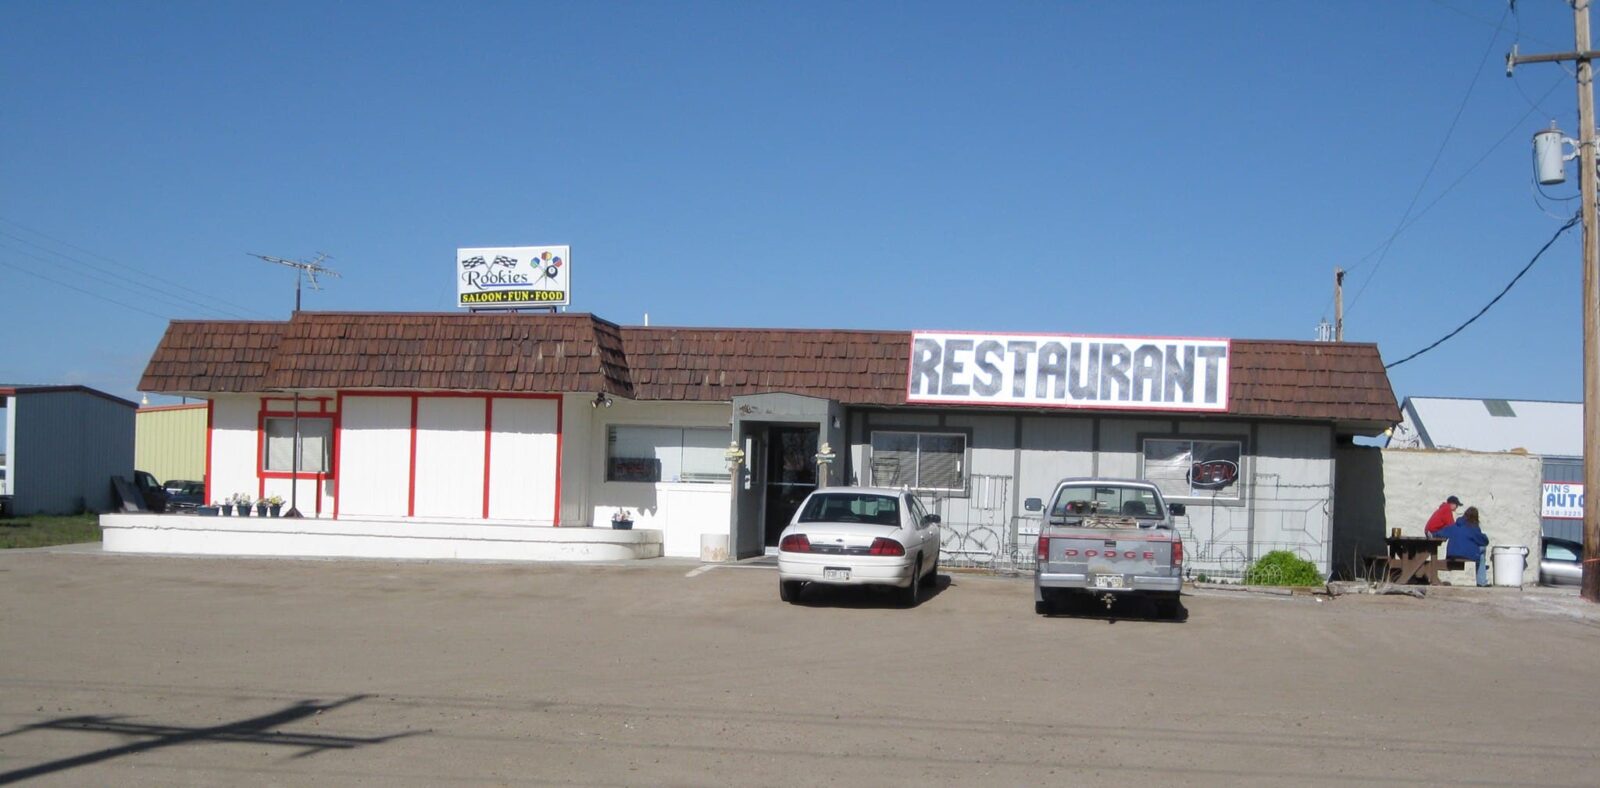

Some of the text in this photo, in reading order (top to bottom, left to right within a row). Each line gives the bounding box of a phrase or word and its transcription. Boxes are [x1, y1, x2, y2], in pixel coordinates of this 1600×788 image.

[461, 270, 528, 290] Rookies
[462, 291, 563, 302] SALOON FUN FOOD
[910, 338, 1227, 403] RESTAURANT
[1064, 549, 1155, 560] DODGE
